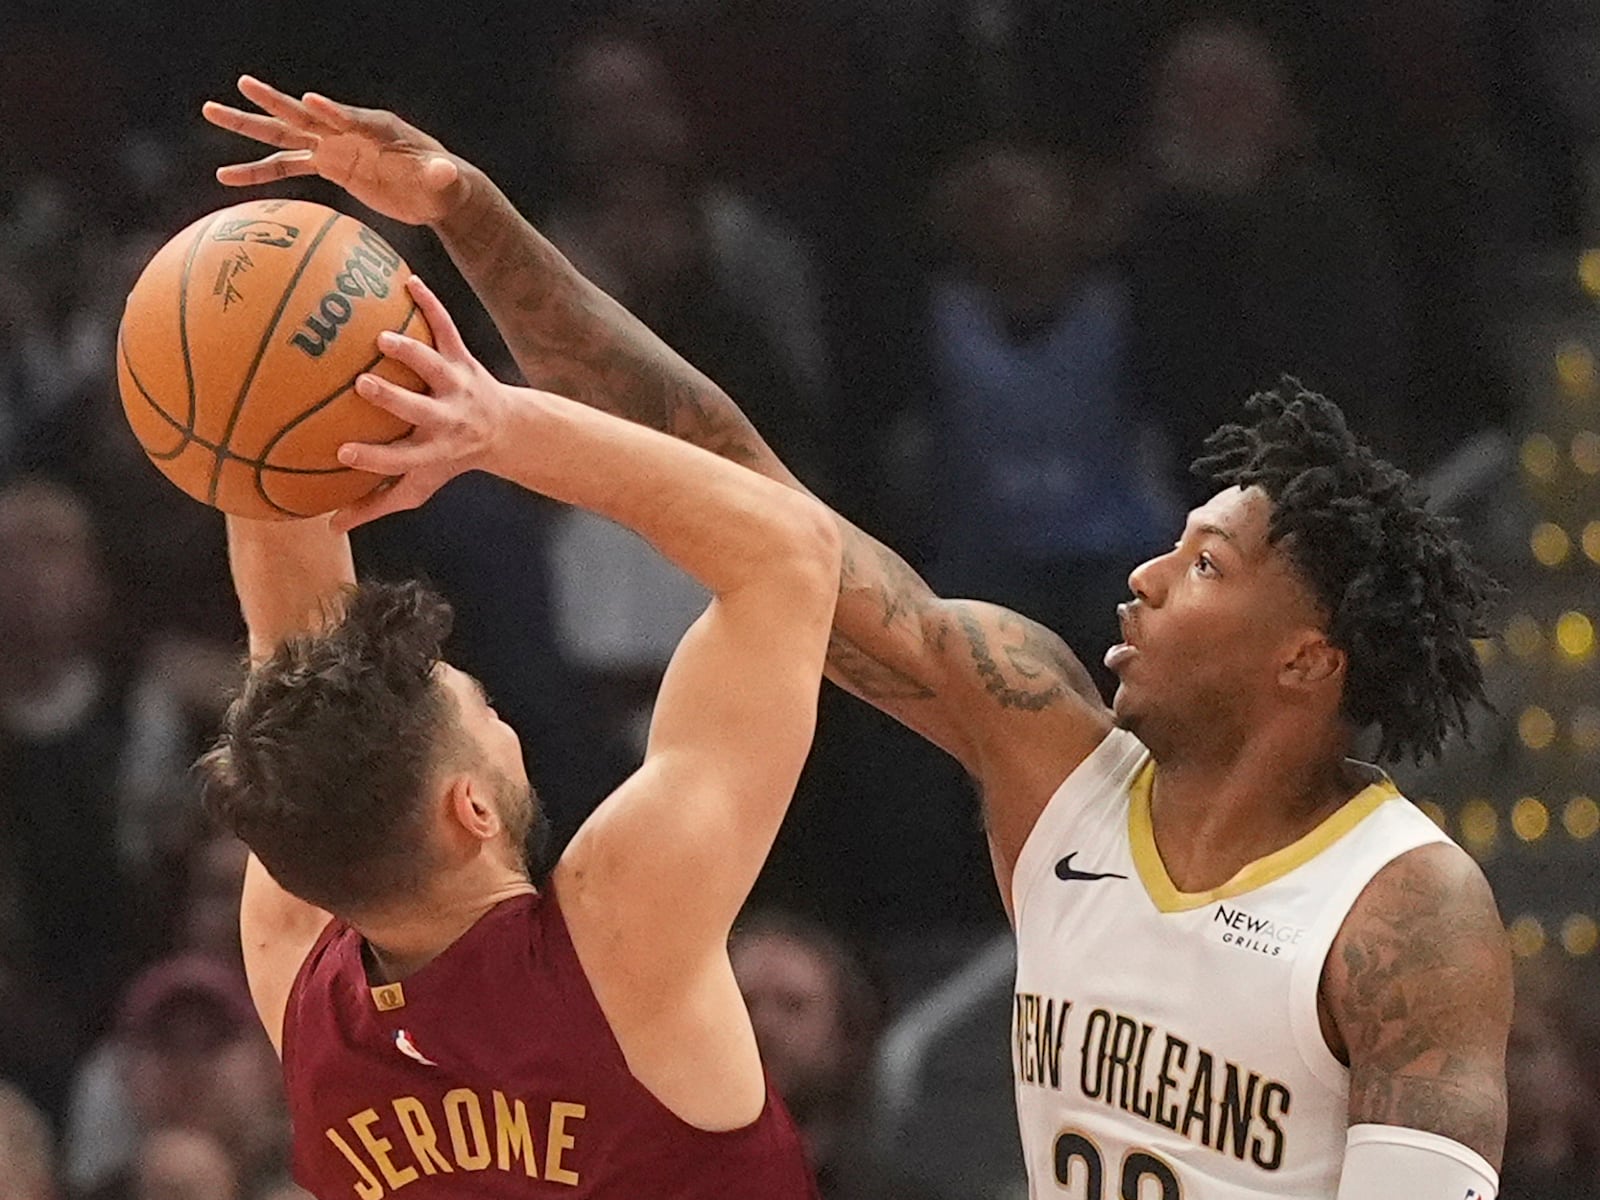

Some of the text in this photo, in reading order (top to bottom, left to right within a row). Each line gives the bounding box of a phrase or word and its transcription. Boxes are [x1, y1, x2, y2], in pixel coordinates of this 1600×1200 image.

[287, 226, 401, 358] Wilson
[1222, 932, 1281, 957] GRILLS
[1080, 1007, 1291, 1172] ORLEANS
